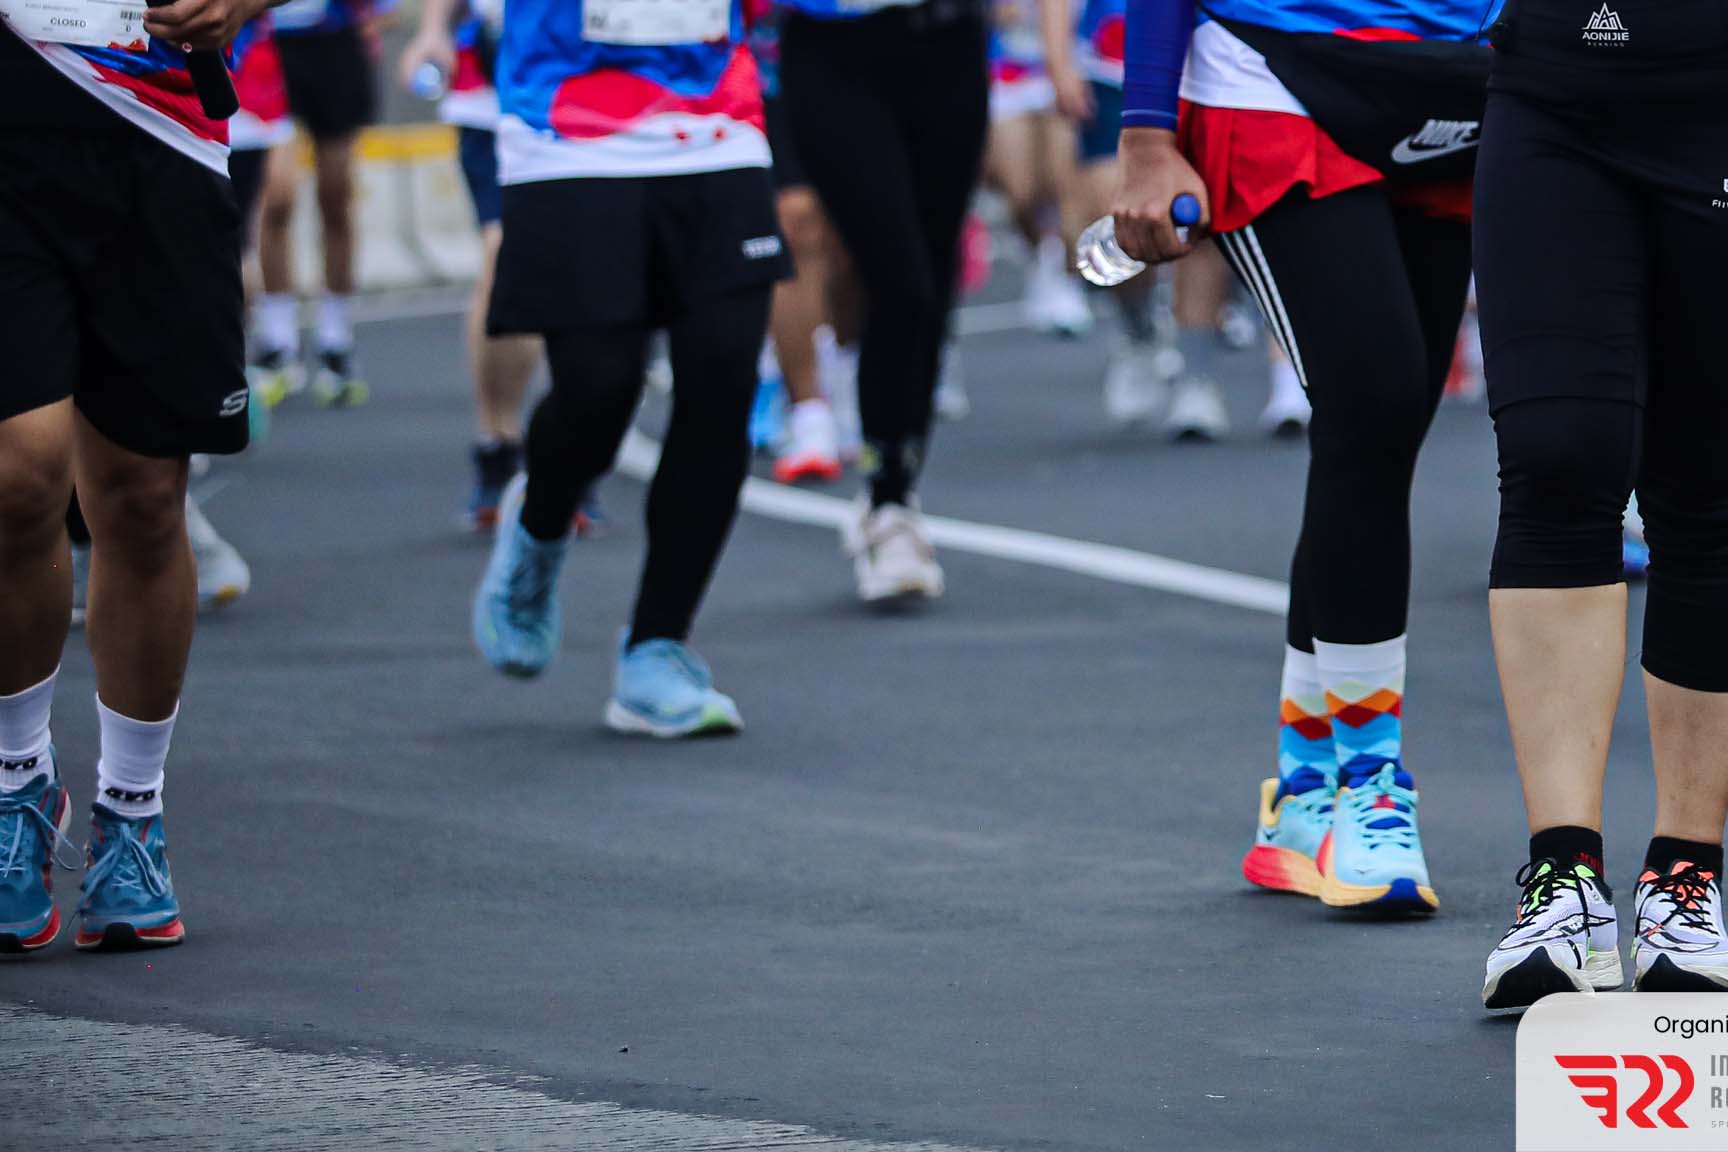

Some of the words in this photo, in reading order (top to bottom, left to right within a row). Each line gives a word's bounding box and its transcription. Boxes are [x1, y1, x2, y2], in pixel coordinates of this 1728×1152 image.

[50, 17, 87, 29] CLOSED
[1582, 31, 1630, 41] AONIJIE
[1411, 118, 1479, 148] NIKE
